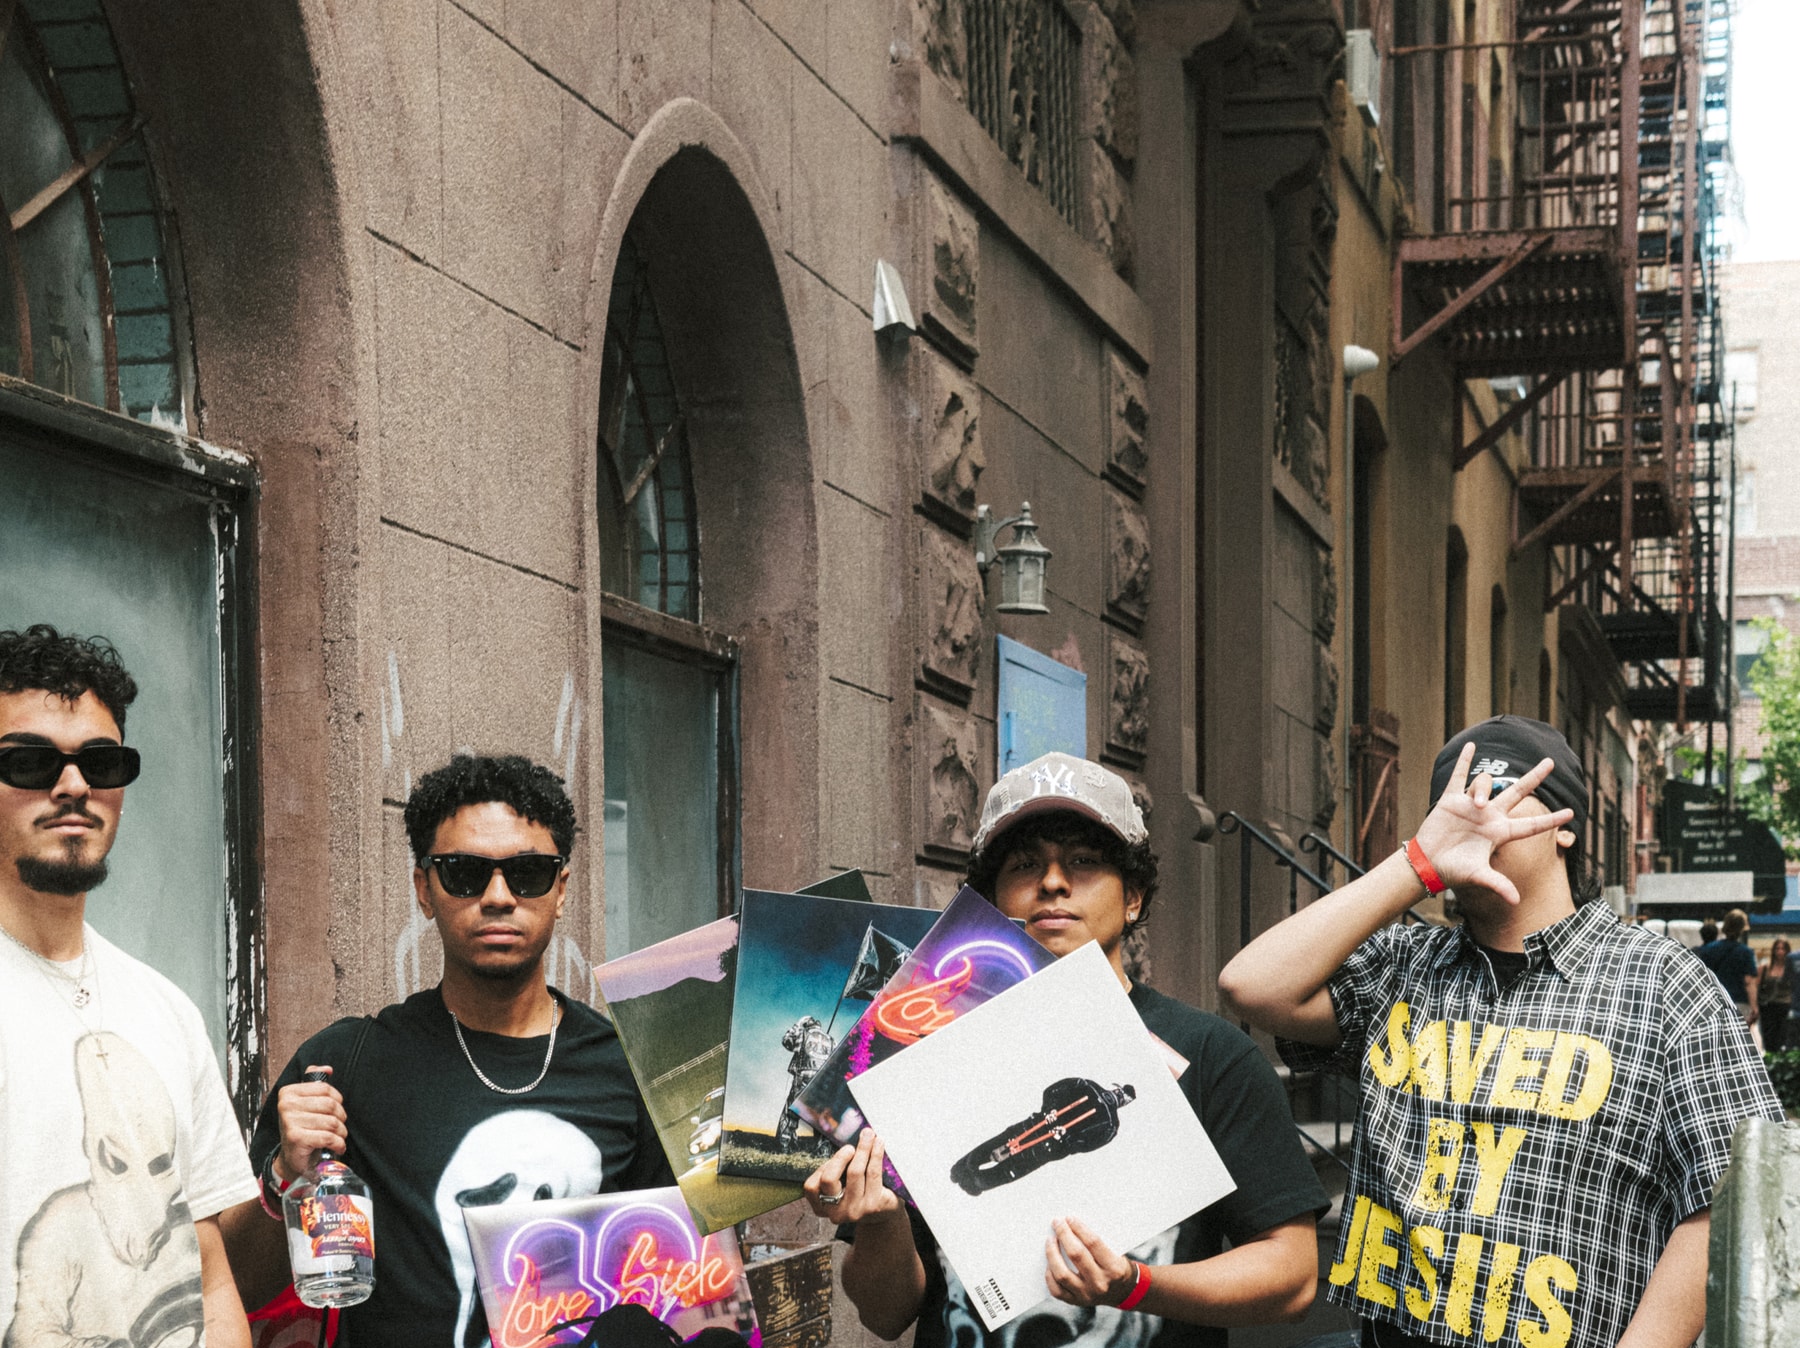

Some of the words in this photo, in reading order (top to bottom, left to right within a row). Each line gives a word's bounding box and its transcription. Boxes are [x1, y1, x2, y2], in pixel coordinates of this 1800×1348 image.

[1030, 763, 1077, 797] NY
[1369, 1001, 1613, 1121] SAVED
[1411, 1117, 1528, 1218] BY
[317, 1211, 366, 1226] Hennessy
[620, 1232, 734, 1306] Sick
